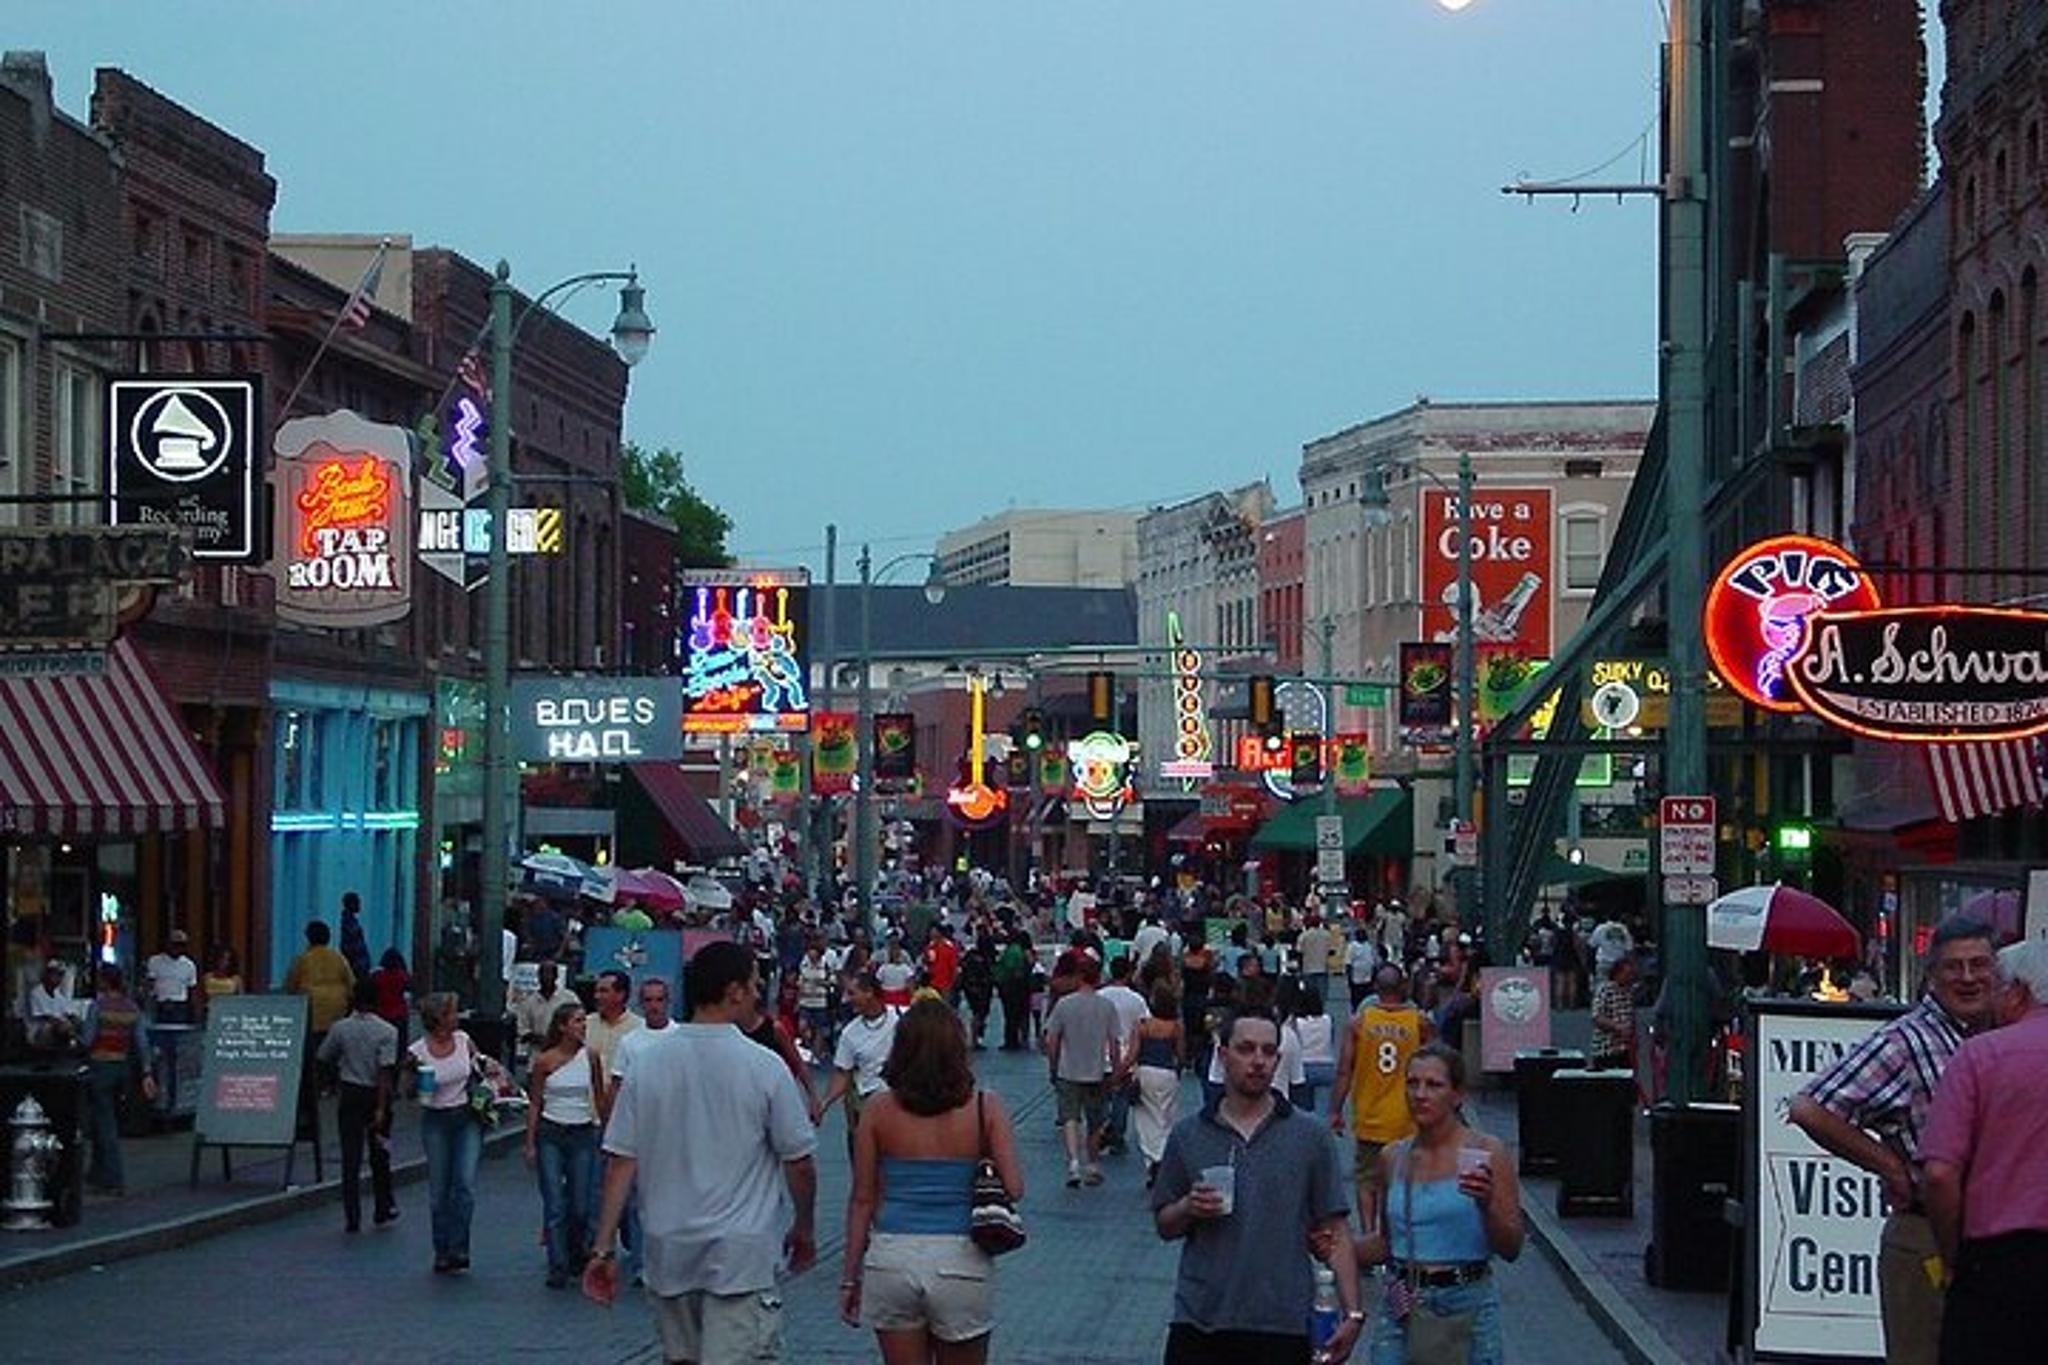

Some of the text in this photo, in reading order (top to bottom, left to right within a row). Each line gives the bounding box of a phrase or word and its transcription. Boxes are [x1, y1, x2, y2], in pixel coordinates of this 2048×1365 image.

[1443, 496, 1531, 519] Hve a
[318, 527, 387, 558] TAP
[1438, 525, 1532, 561] Coke
[288, 553, 394, 588] ROOM
[1729, 551, 1859, 599] PIT
[536, 697, 655, 725] BLUES
[1856, 697, 1999, 723] ESTABLISHED
[548, 730, 643, 757] HALL
[1671, 804, 1706, 820] NO
[1378, 1042, 1398, 1073] 8
[1789, 1236, 1873, 1294] Cen
